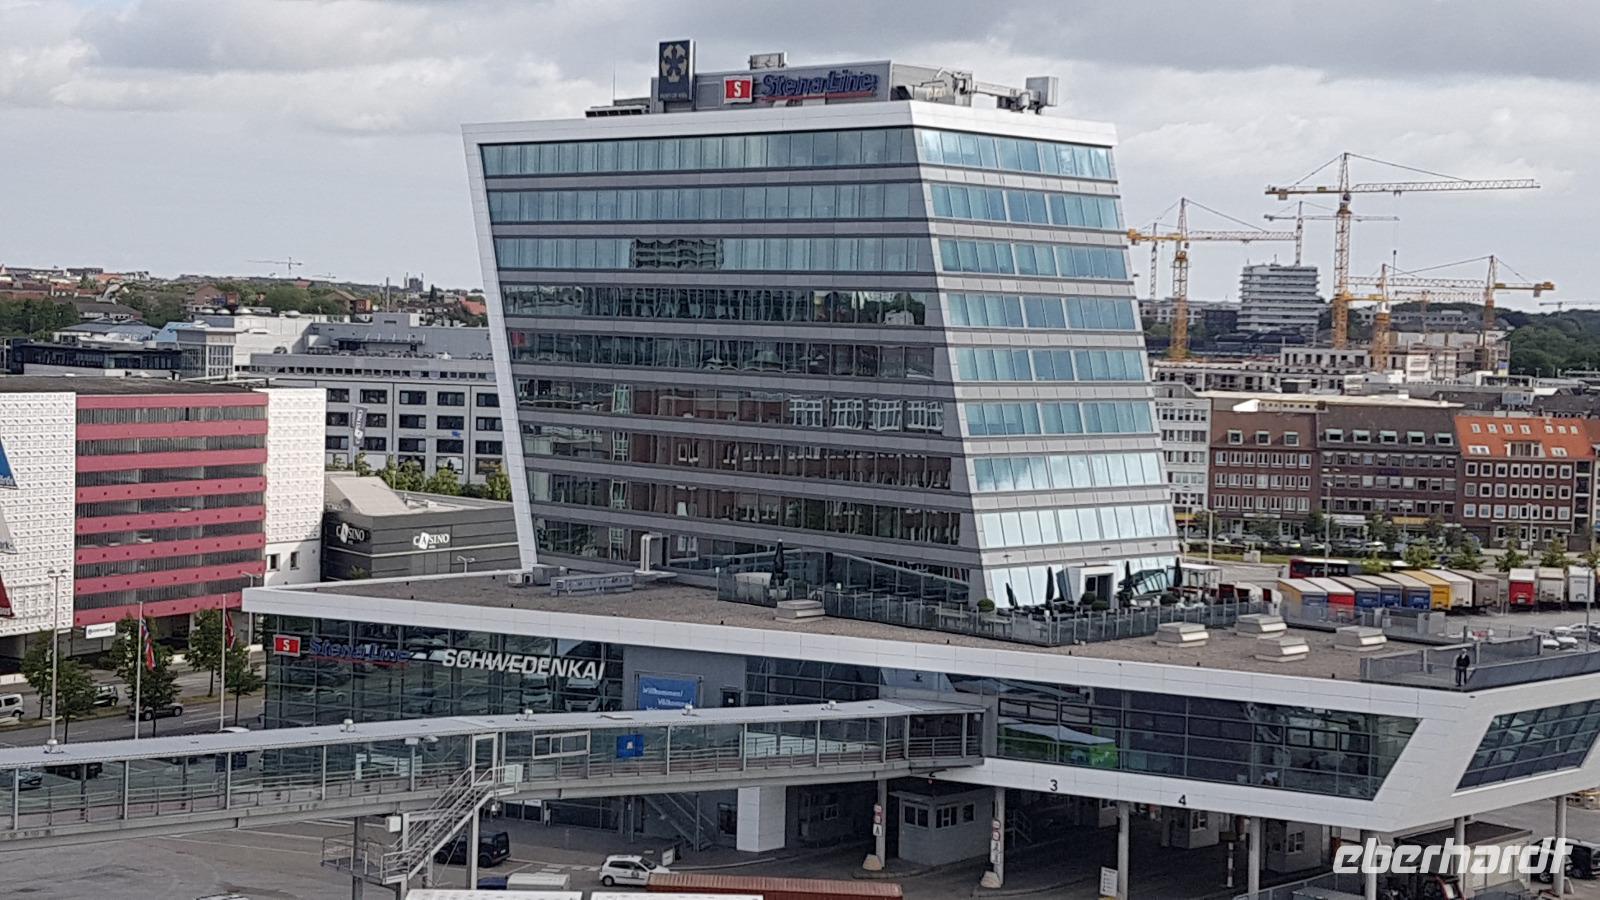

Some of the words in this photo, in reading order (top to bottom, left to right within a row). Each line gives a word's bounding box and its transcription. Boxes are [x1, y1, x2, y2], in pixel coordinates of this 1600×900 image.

[336, 522, 365, 543] CASINO
[413, 532, 450, 549] CASINO
[442, 648, 606, 681] SCHWEDENKAI
[1049, 778, 1058, 792] 3
[1178, 794, 1187, 806] 4
